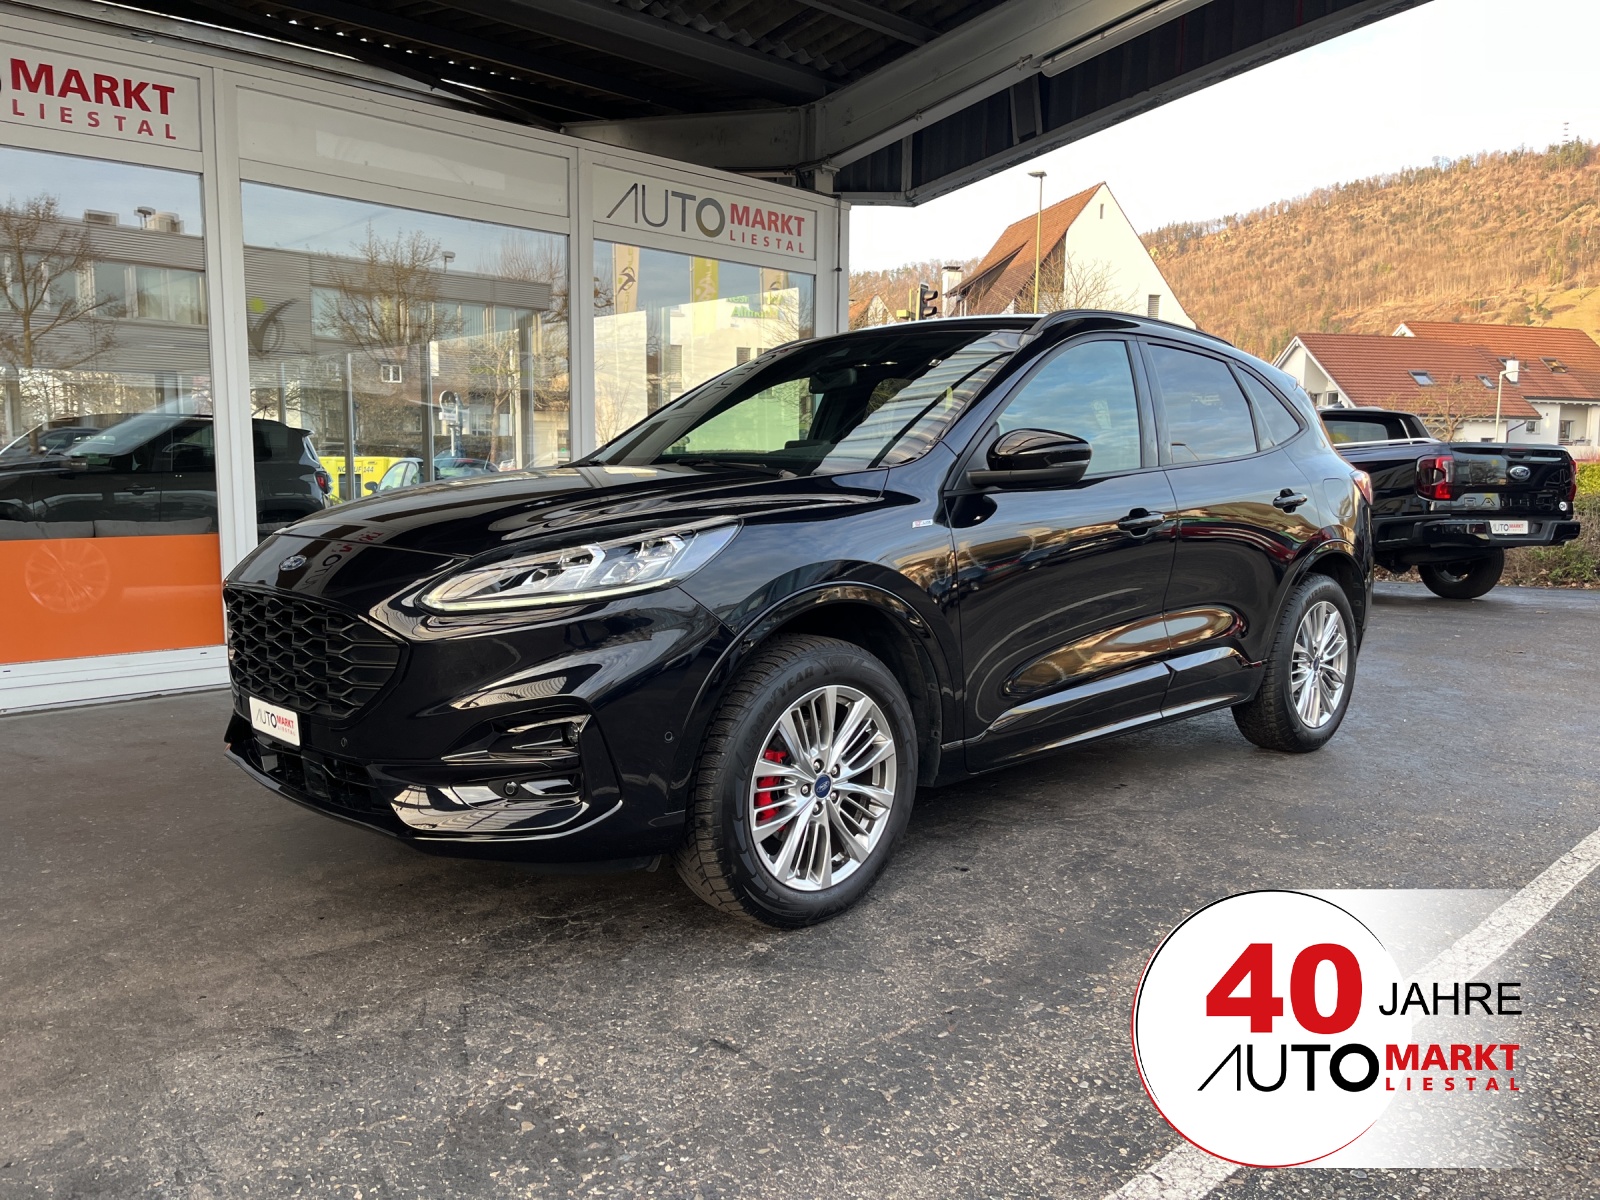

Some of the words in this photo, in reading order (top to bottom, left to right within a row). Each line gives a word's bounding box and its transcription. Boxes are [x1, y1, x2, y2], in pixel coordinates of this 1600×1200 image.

[10, 57, 175, 115] MARKT
[12, 98, 177, 140] LIESTAL
[606, 182, 726, 238] AUTO
[730, 203, 805, 237] MARKT
[729, 229, 805, 254] LIESTAL
[276, 715, 294, 729] MARKT
